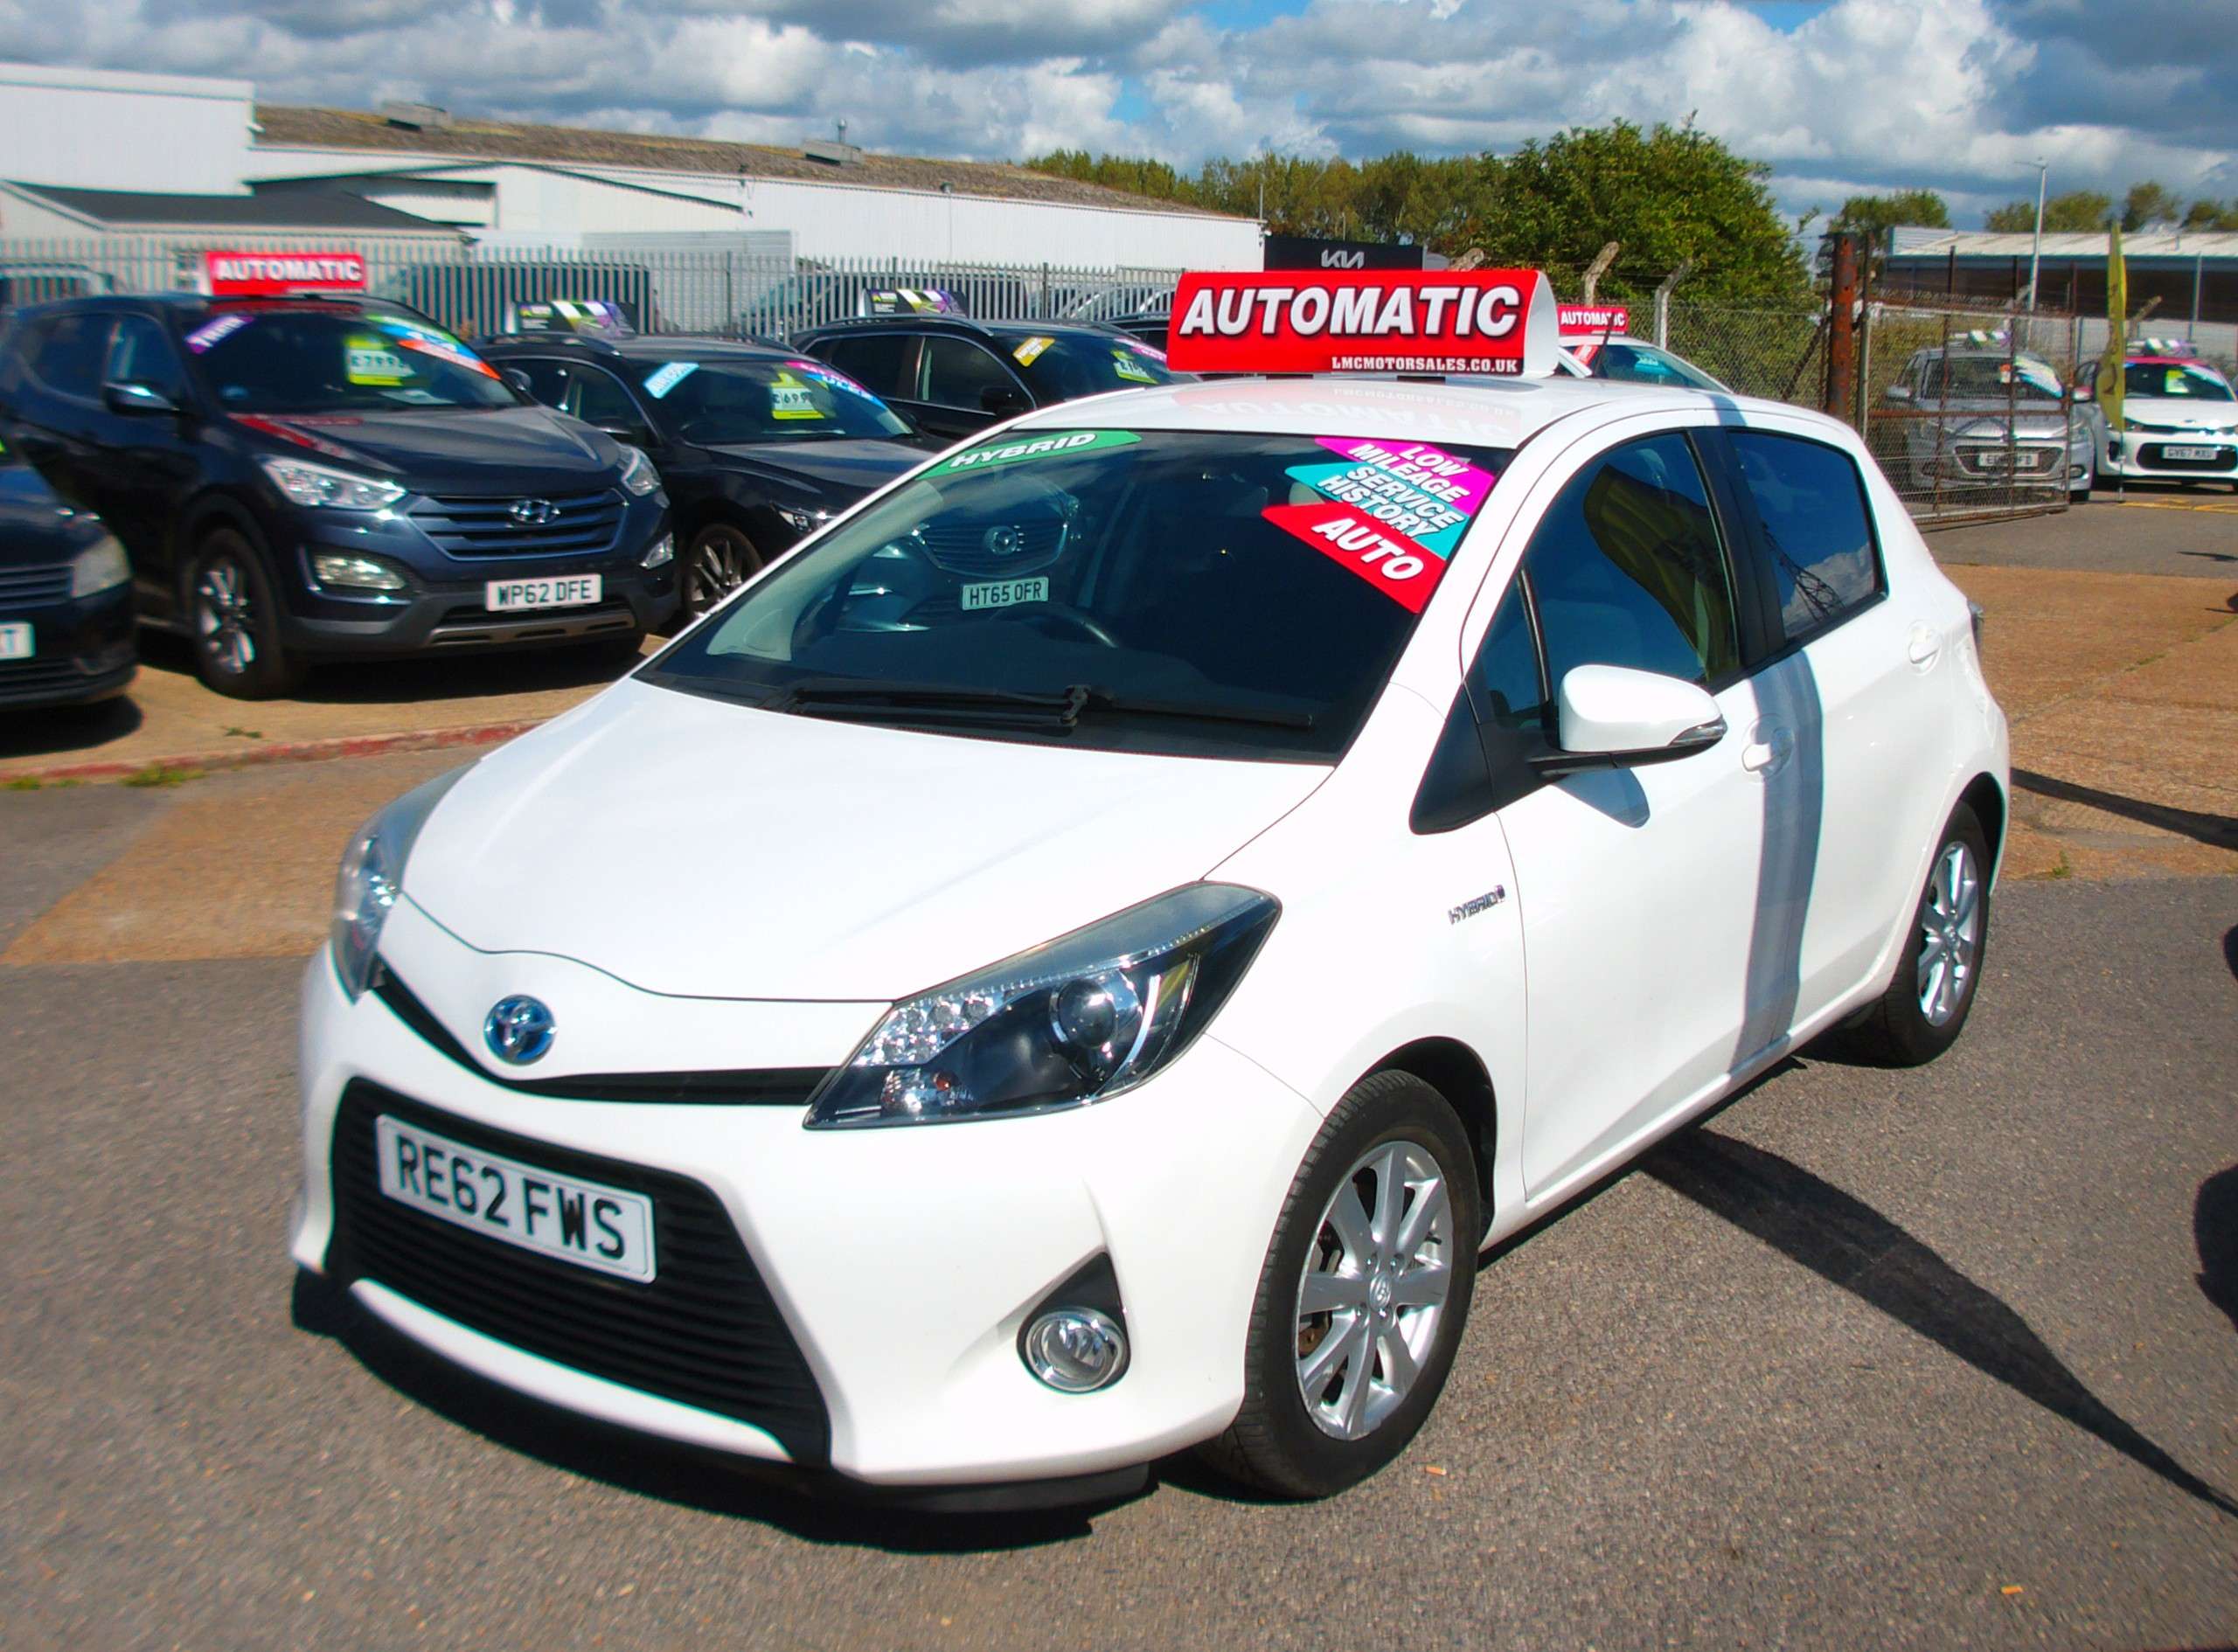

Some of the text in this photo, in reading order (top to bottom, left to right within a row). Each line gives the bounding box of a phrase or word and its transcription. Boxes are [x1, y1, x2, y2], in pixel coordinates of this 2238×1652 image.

[216, 260, 363, 281] AUTOMATIC
[1178, 285, 1520, 337] AUTOMATIC
[1331, 356, 1518, 373] LMCMOTORSALES.CO.UK
[949, 433, 1097, 469] HYBRID
[1399, 445, 1470, 477] LOW
[1347, 443, 1471, 503] MILEAGE
[1317, 475, 1440, 538] HISTORY
[1346, 466, 1465, 529] SERVICE
[1310, 517, 1425, 580] AUTO
[497, 579, 592, 606] WP62 DFE
[969, 581, 1042, 606] HT65 OFR
[1448, 892, 1498, 925] HYBRID
[397, 1134, 626, 1260] RE62 FWS
